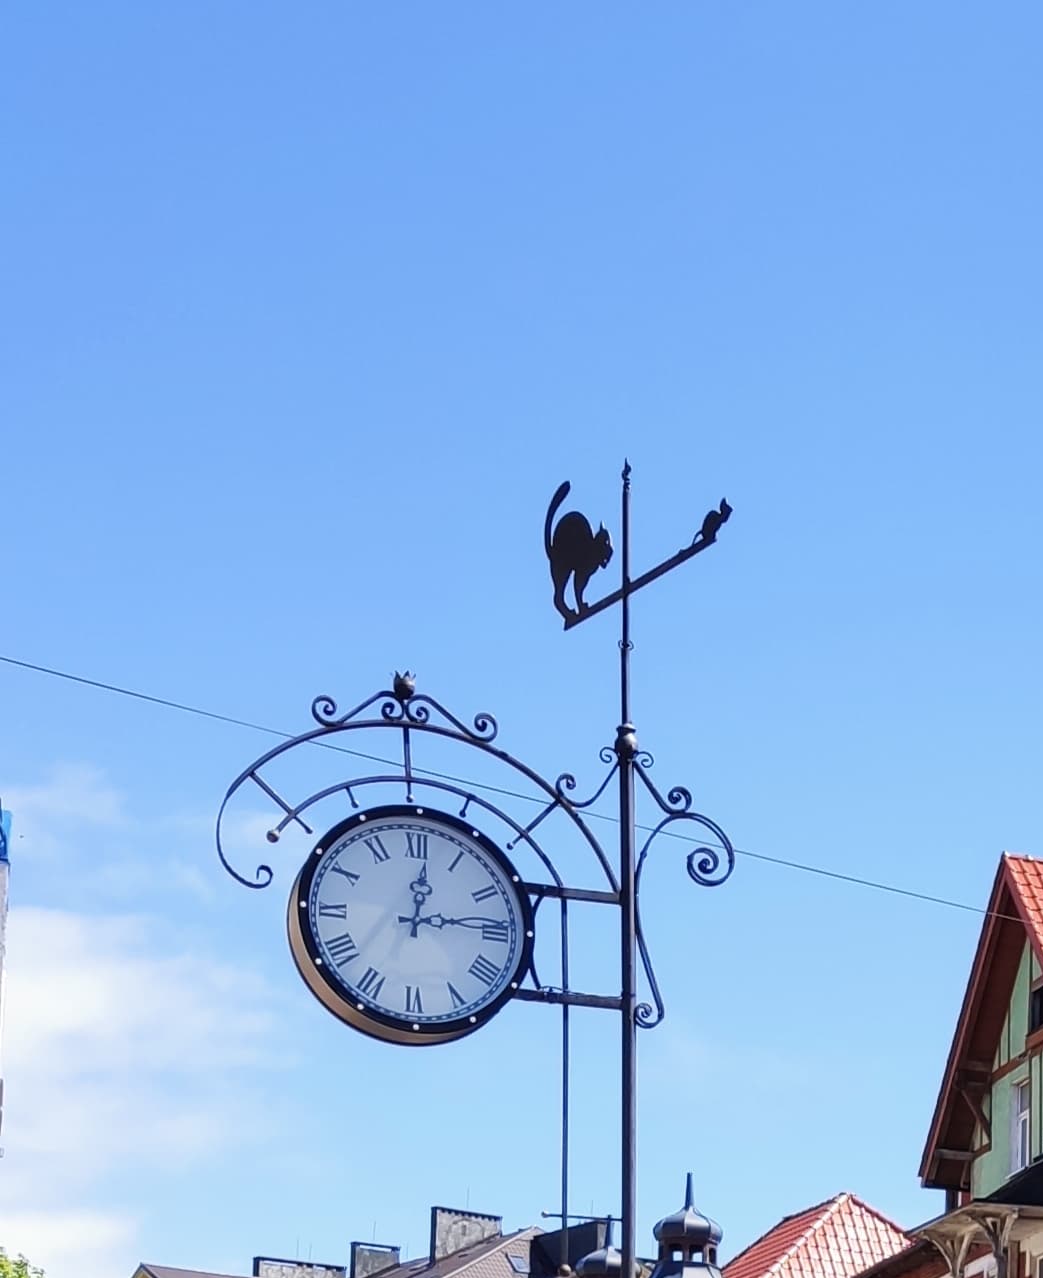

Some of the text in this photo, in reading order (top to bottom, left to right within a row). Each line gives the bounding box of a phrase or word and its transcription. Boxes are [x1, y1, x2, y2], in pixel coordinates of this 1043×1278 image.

[363, 835, 391, 864] XI
[404, 832, 428, 860] XII
[331, 861, 361, 886] X
[447, 851, 466, 872] I
[471, 884, 499, 903] II
[318, 902, 347, 920] IX
[482, 924, 509, 943] III
[325, 934, 360, 968] VIII
[356, 967, 386, 1001] VII
[468, 954, 502, 986] IIII
[405, 985, 424, 1014] VI
[447, 981, 467, 1009] V
